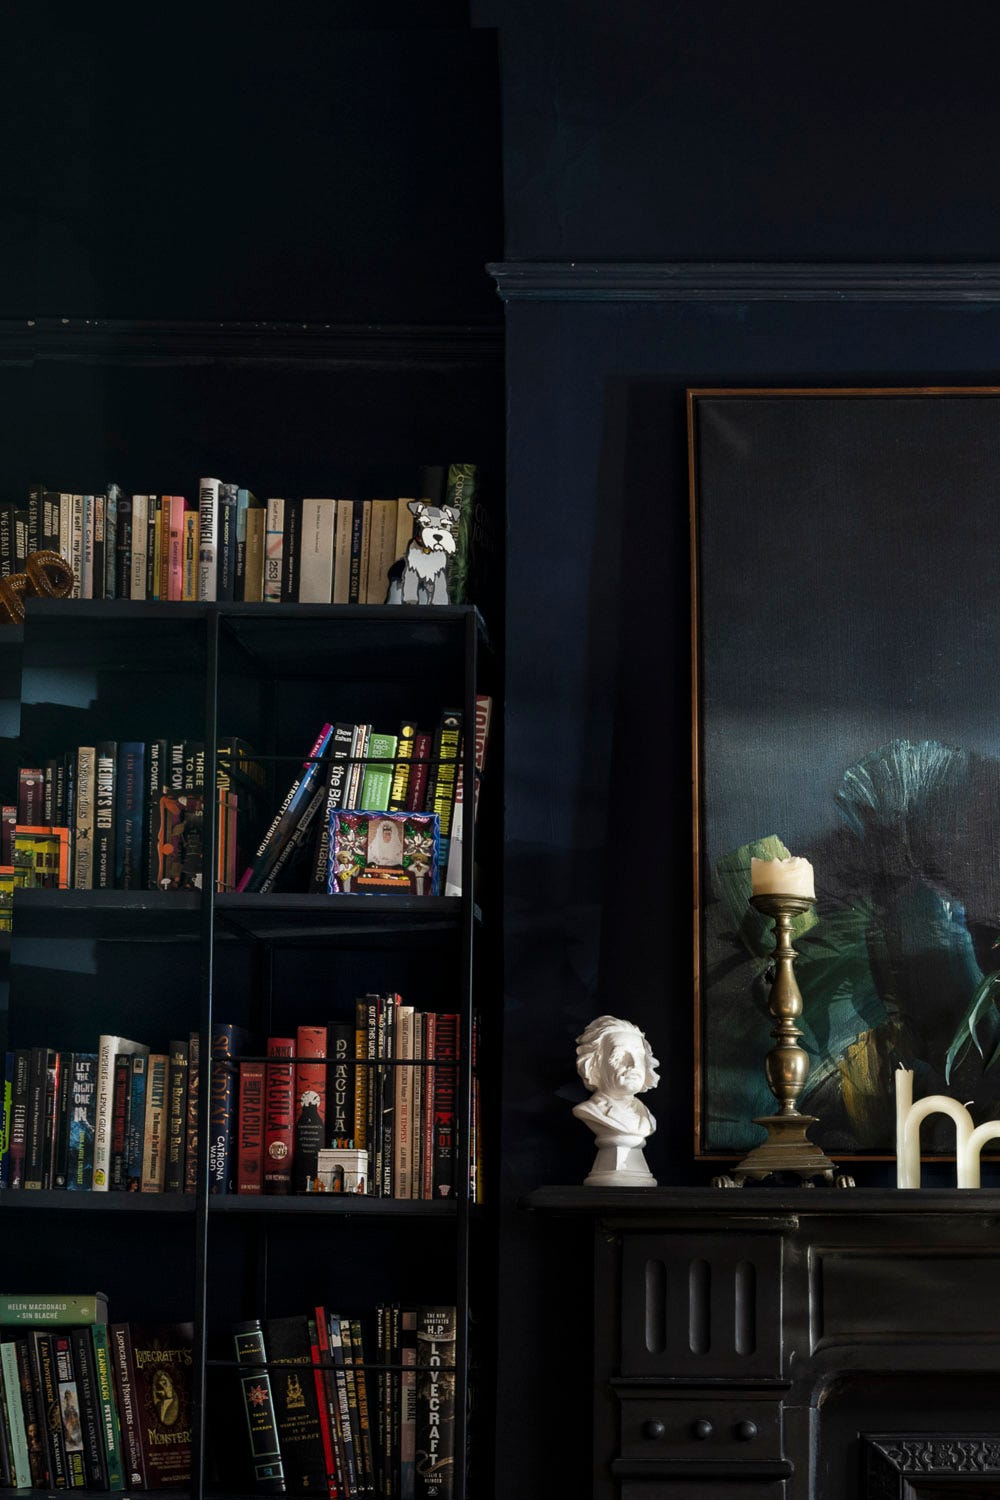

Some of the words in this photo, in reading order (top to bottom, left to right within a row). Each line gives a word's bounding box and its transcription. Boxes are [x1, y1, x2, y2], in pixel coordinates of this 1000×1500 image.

[200, 488, 214, 545] MOTHERWELL
[73, 540, 80, 552] my
[74, 574, 80, 583] of
[269, 561, 278, 579] 253
[201, 566, 210, 597] Deborah
[350, 575, 358, 597] ZONE
[334, 734, 352, 743] Eshun
[336, 728, 352, 737] Ekow
[441, 730, 458, 745] THE
[151, 744, 159, 759] TIM
[172, 745, 183, 764] TIM
[185, 757, 194, 772] TO
[195, 752, 205, 787] THREE
[391, 740, 414, 801] WACHMEN
[79, 763, 90, 796] STRANGER
[97, 758, 113, 806] MEDUSA'S
[330, 766, 344, 787] the
[278, 780, 300, 815] ATROCITY
[435, 782, 453, 797] THE
[79, 798, 89, 819] TIDES
[97, 808, 112, 829] WEB
[256, 815, 282, 858] EXHIBITION
[368, 1005, 376, 1018] OUT
[368, 1019, 376, 1027] OF
[368, 1027, 376, 1039] THIS
[75, 1062, 92, 1072] LET
[101, 1045, 110, 1080] VAMPIRES
[16, 1057, 24, 1095] GRIMWOOD
[75, 1073, 89, 1081] THE
[152, 1062, 166, 1108] MORIARTY
[174, 1073, 182, 1086] THE
[335, 1040, 348, 1133] DRACULA
[73, 1082, 94, 1093] RIGHT
[268, 1064, 292, 1132] RACULA
[74, 1094, 91, 1105] ONE
[99, 1093, 107, 1117] LEMON
[171, 1087, 183, 1115] BLOODY
[13, 1104, 26, 1143] FELAHEEN
[74, 1107, 87, 1122] IN
[242, 1088, 261, 1149] DRACULA
[98, 1118, 106, 1143] GROVE
[171, 1118, 182, 1135] RED
[383, 1127, 392, 1142] ONE
[170, 1137, 182, 1163] BARON
[216, 1136, 225, 1180] CATRIONA
[383, 1145, 391, 1166] PHASE
[383, 1166, 391, 1195] ZENITH
[34, 1311, 58, 1319] BLACHÉ
[427, 1326, 444, 1335] H.P.
[79, 1348, 89, 1376] GOTHIC
[116, 1331, 130, 1383] LOVECRAFT'S
[134, 1348, 192, 1369] LOVECRAFT'S
[43, 1357, 54, 1402] PROVIDENCE
[97, 1348, 110, 1401] REANIMATORS
[82, 1378, 91, 1399] TALES
[121, 1384, 134, 1425] MONSTERS
[338, 1388, 349, 1414] MOUNTAINS
[407, 1389, 417, 1421] JOURNAL
[429, 1342, 441, 1467] LOVECRAFT
[104, 1405, 112, 1421] PETE
[87, 1422, 99, 1462] LOVECRAFT
[105, 1424, 115, 1451] RAWLIK
[128, 1432, 136, 1447] ELLEN
[129, 1448, 137, 1469] DATLOW
